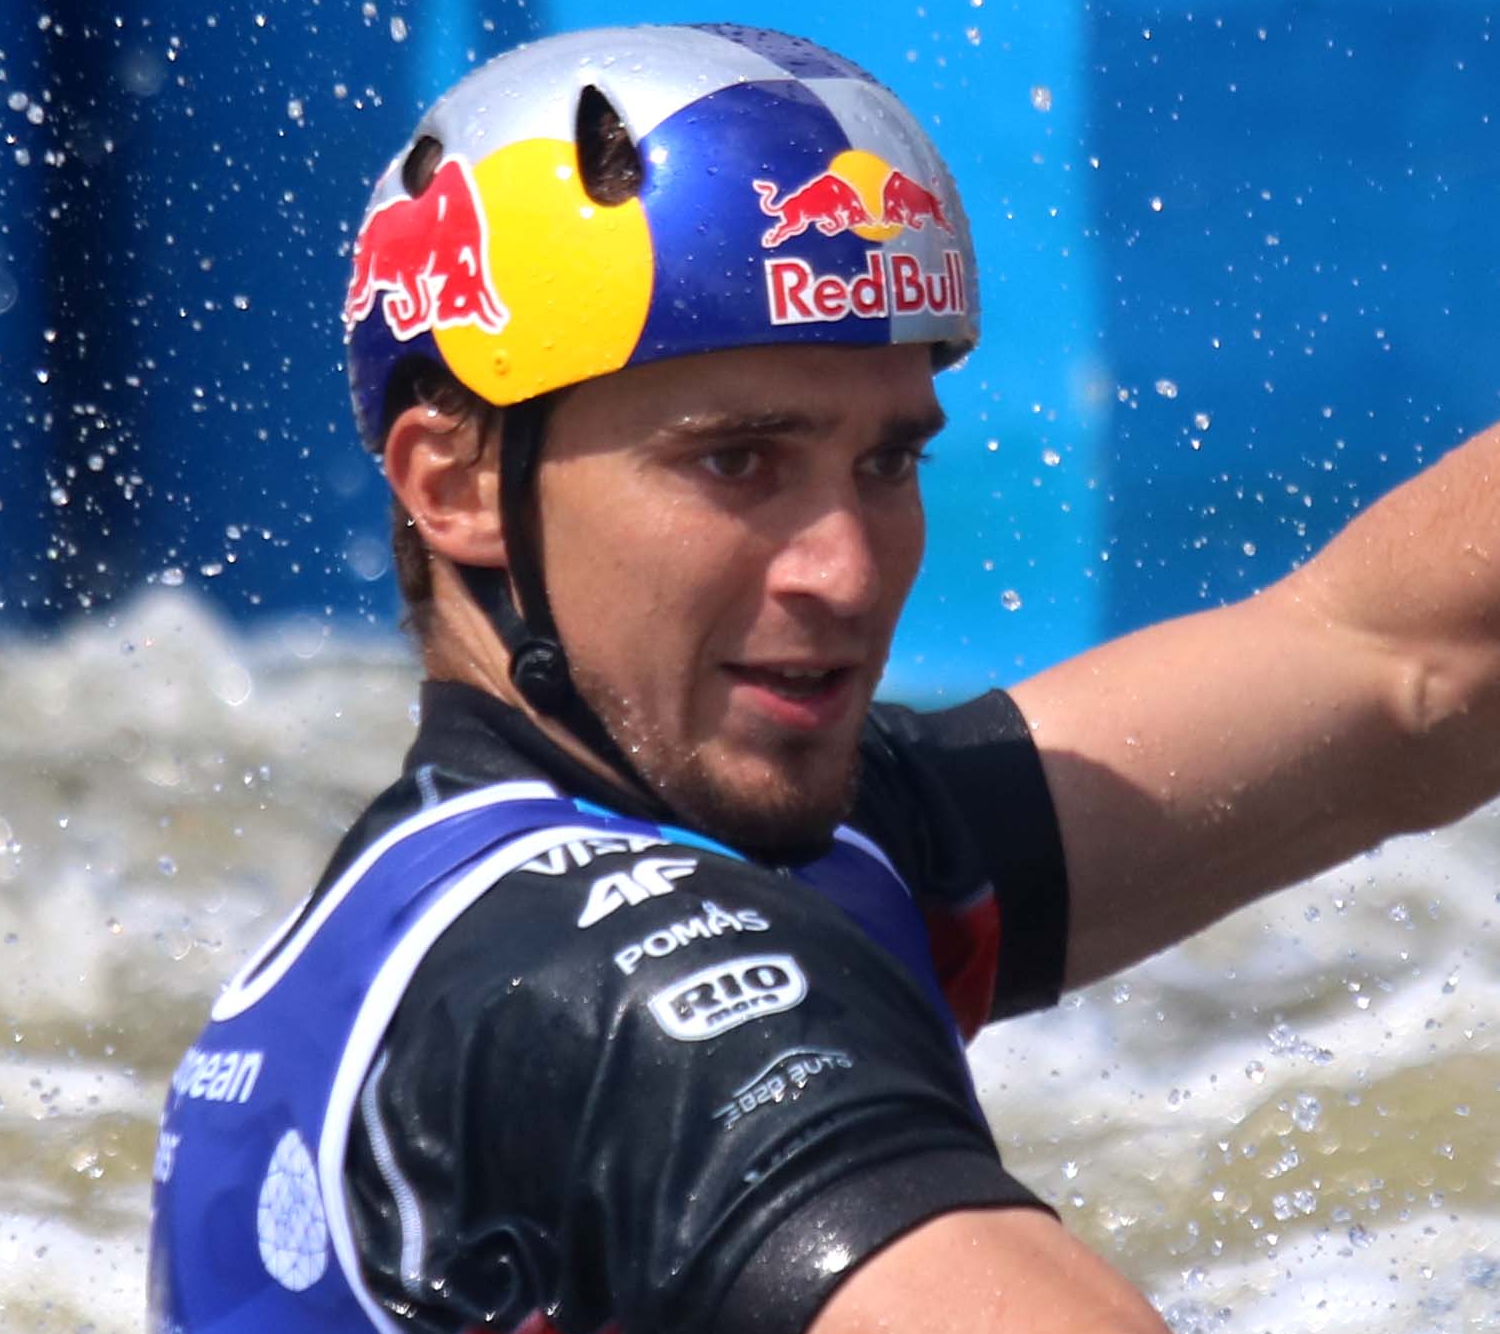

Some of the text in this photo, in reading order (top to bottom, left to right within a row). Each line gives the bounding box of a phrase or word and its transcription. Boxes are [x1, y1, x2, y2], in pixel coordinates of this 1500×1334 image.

[768, 250, 966, 322] Red Bull
[668, 964, 792, 1023] RIO
